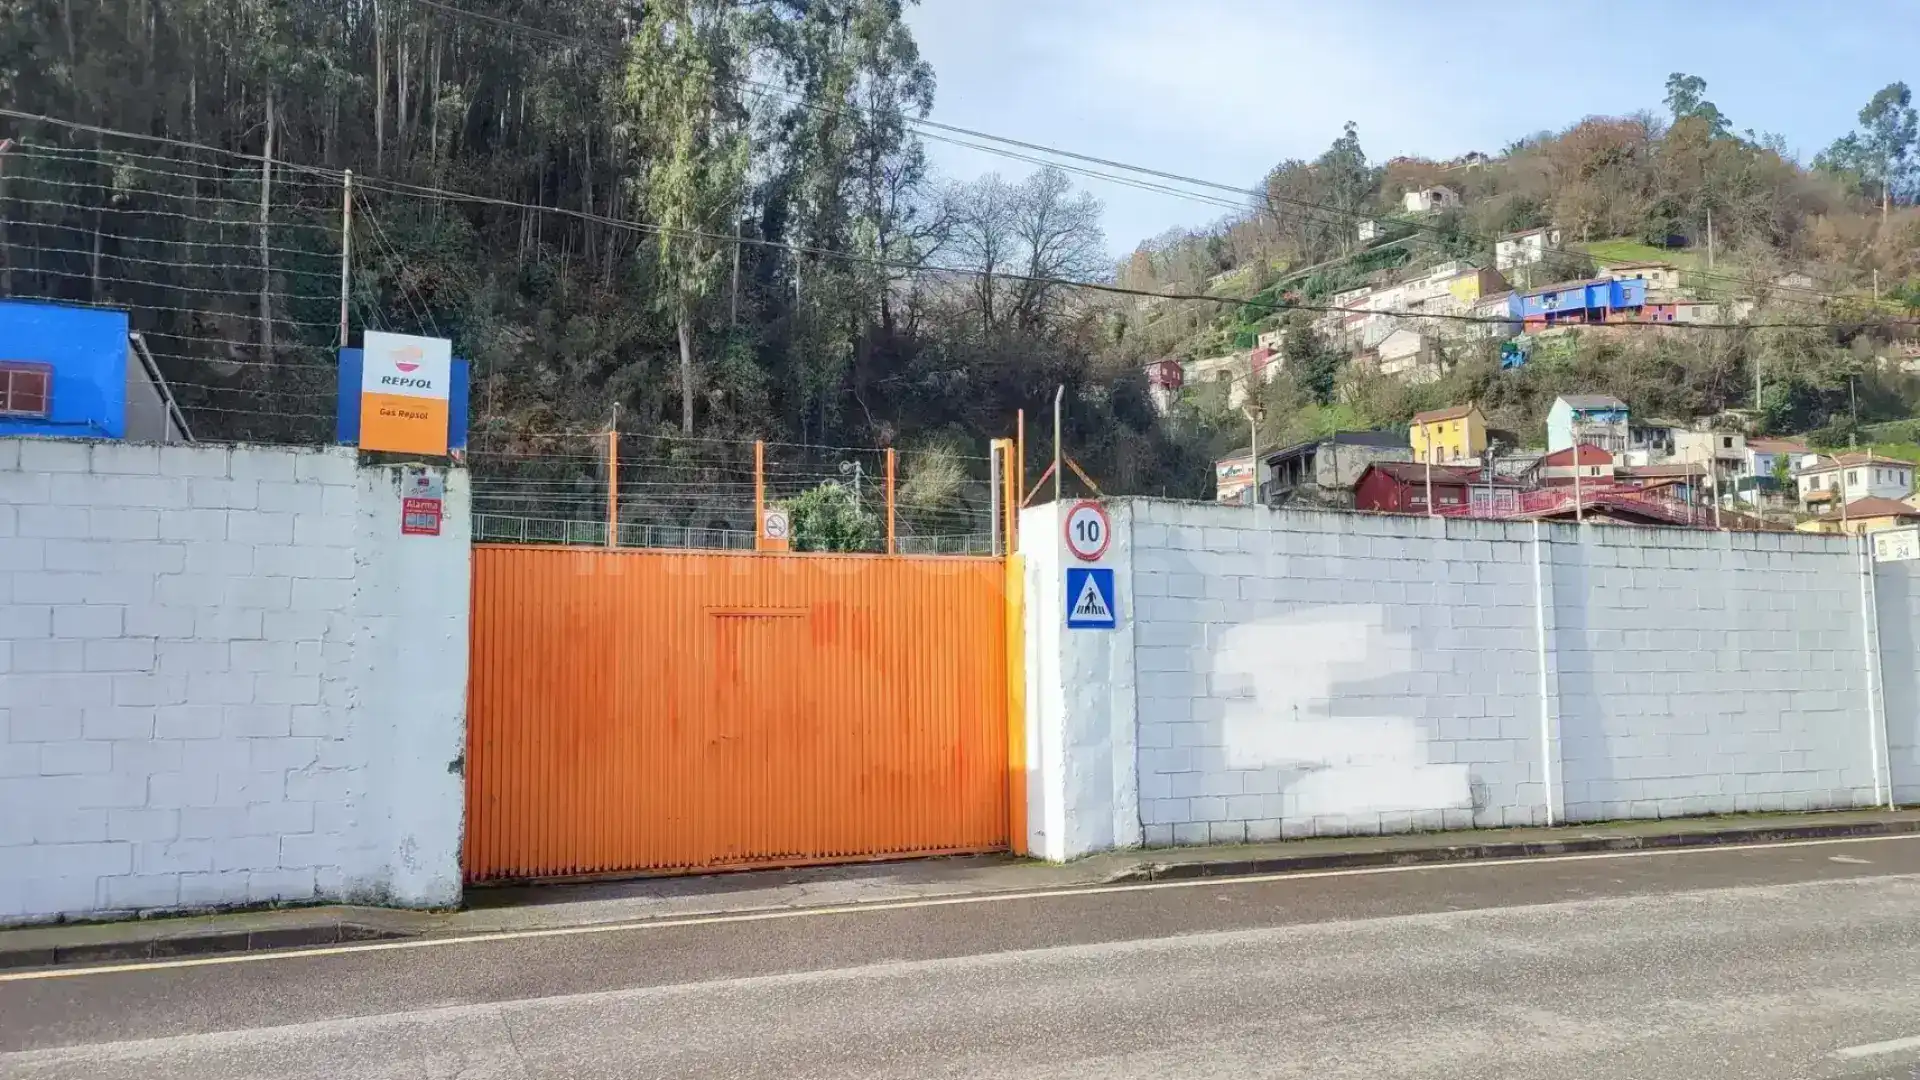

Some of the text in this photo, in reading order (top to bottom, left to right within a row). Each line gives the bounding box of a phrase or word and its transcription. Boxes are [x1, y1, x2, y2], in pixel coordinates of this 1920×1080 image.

[381, 376, 432, 389] REPSOL
[380, 408, 429, 420] Gas Repsol
[406, 499, 439, 510] Alarma
[1076, 520, 1099, 542] 10
[1896, 546, 1910, 559] 24
